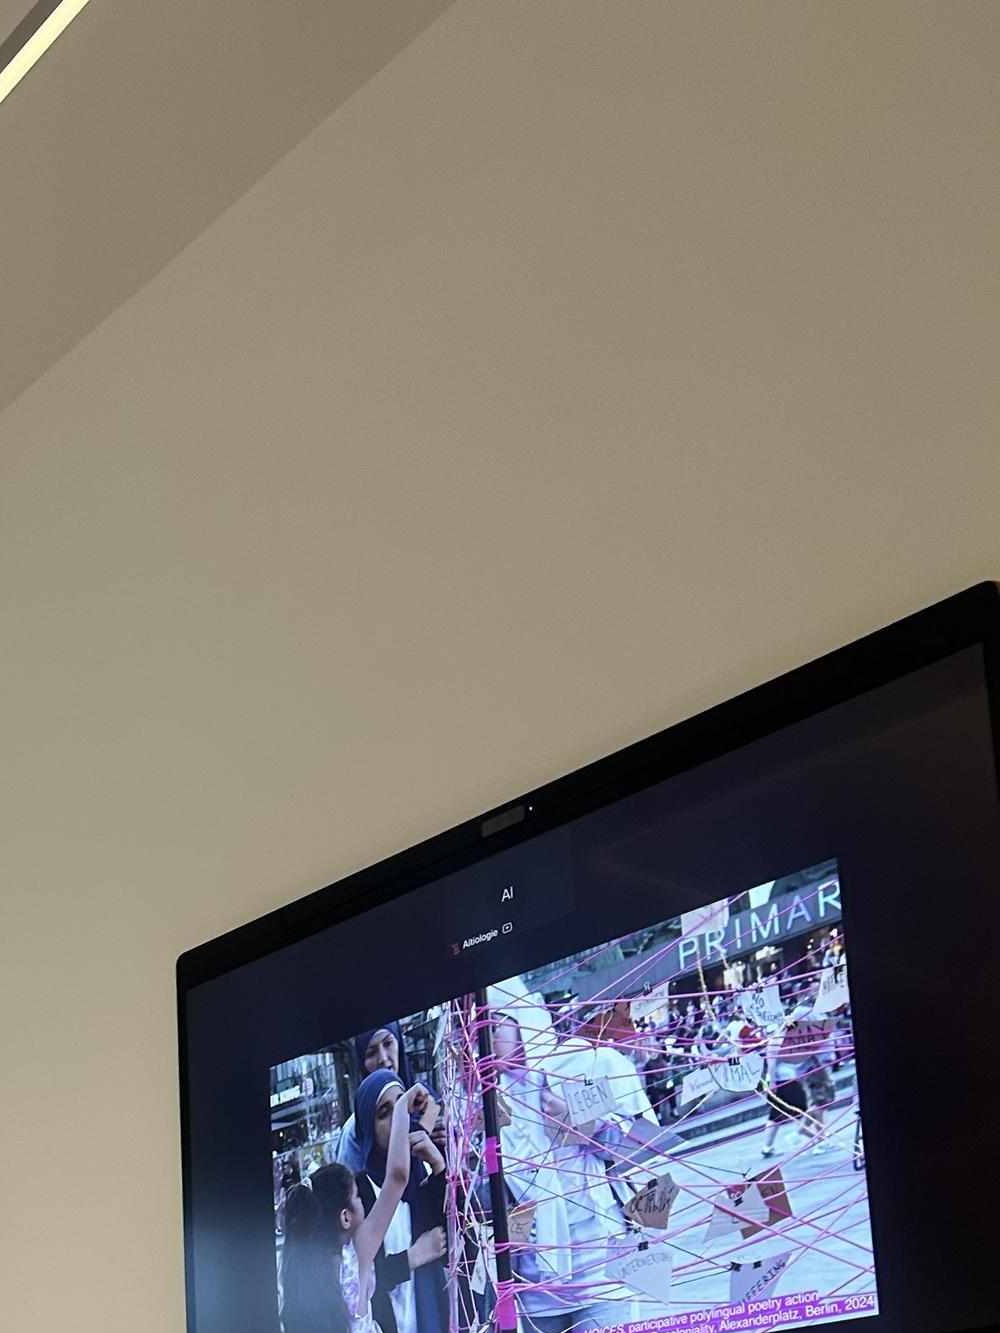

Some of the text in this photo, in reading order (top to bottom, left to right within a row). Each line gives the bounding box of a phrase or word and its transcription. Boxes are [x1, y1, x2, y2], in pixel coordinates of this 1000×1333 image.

[678, 881, 841, 970] PRIMAR
[689, 1304, 745, 1325] polylingual
[747, 1297, 782, 1313] poetry
[785, 1291, 819, 1306] action
[719, 1309, 802, 1331] Alexanderplatz,
[805, 1301, 842, 1318] Berlin,
[844, 1296, 874, 1311] 2024
